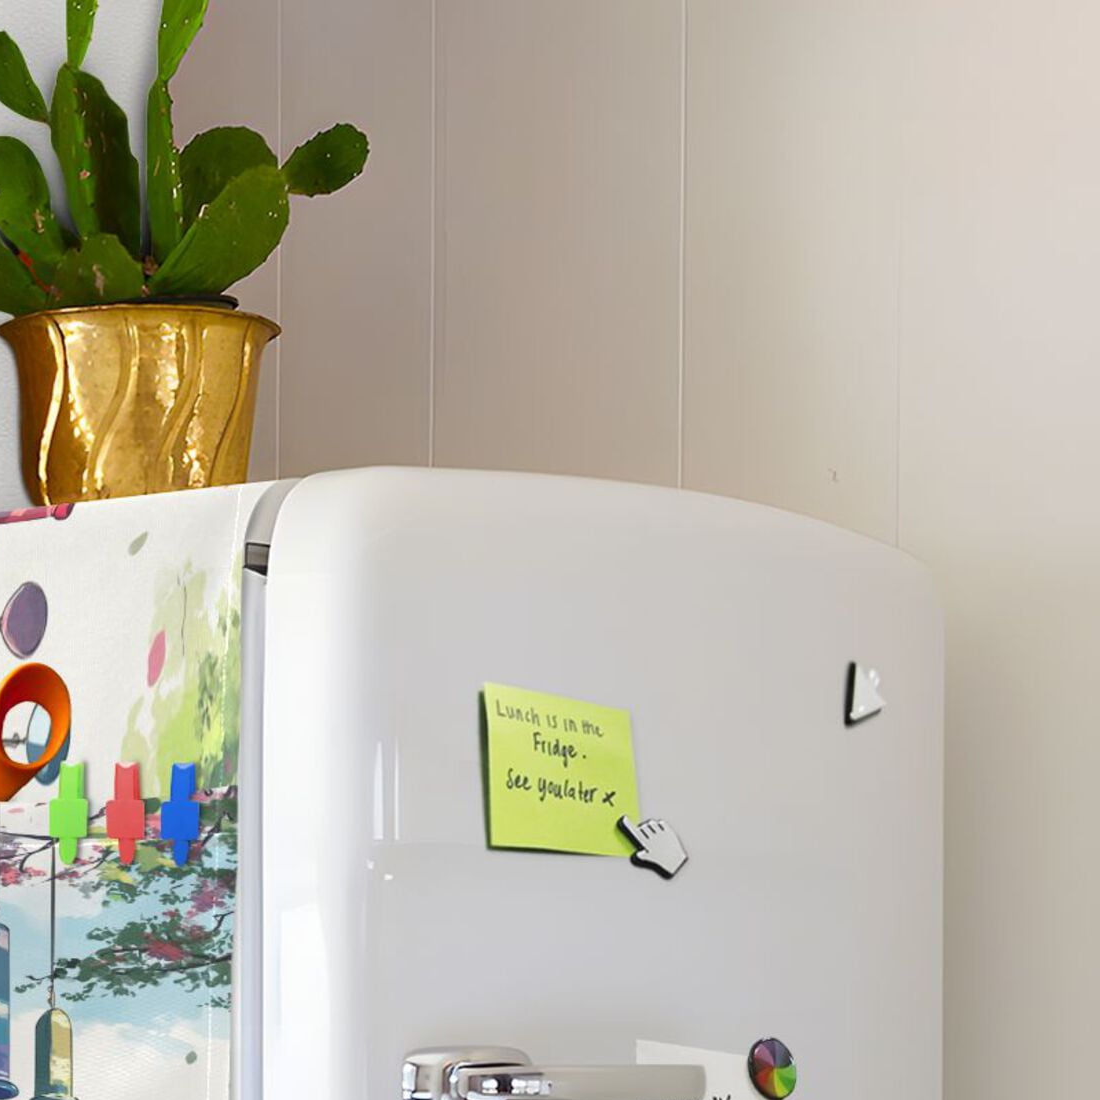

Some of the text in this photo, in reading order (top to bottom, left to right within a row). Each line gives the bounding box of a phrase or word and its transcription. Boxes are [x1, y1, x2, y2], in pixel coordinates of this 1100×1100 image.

[495, 699, 541, 728] Lunch
[582, 719, 604, 738] the
[506, 768, 532, 791] See
